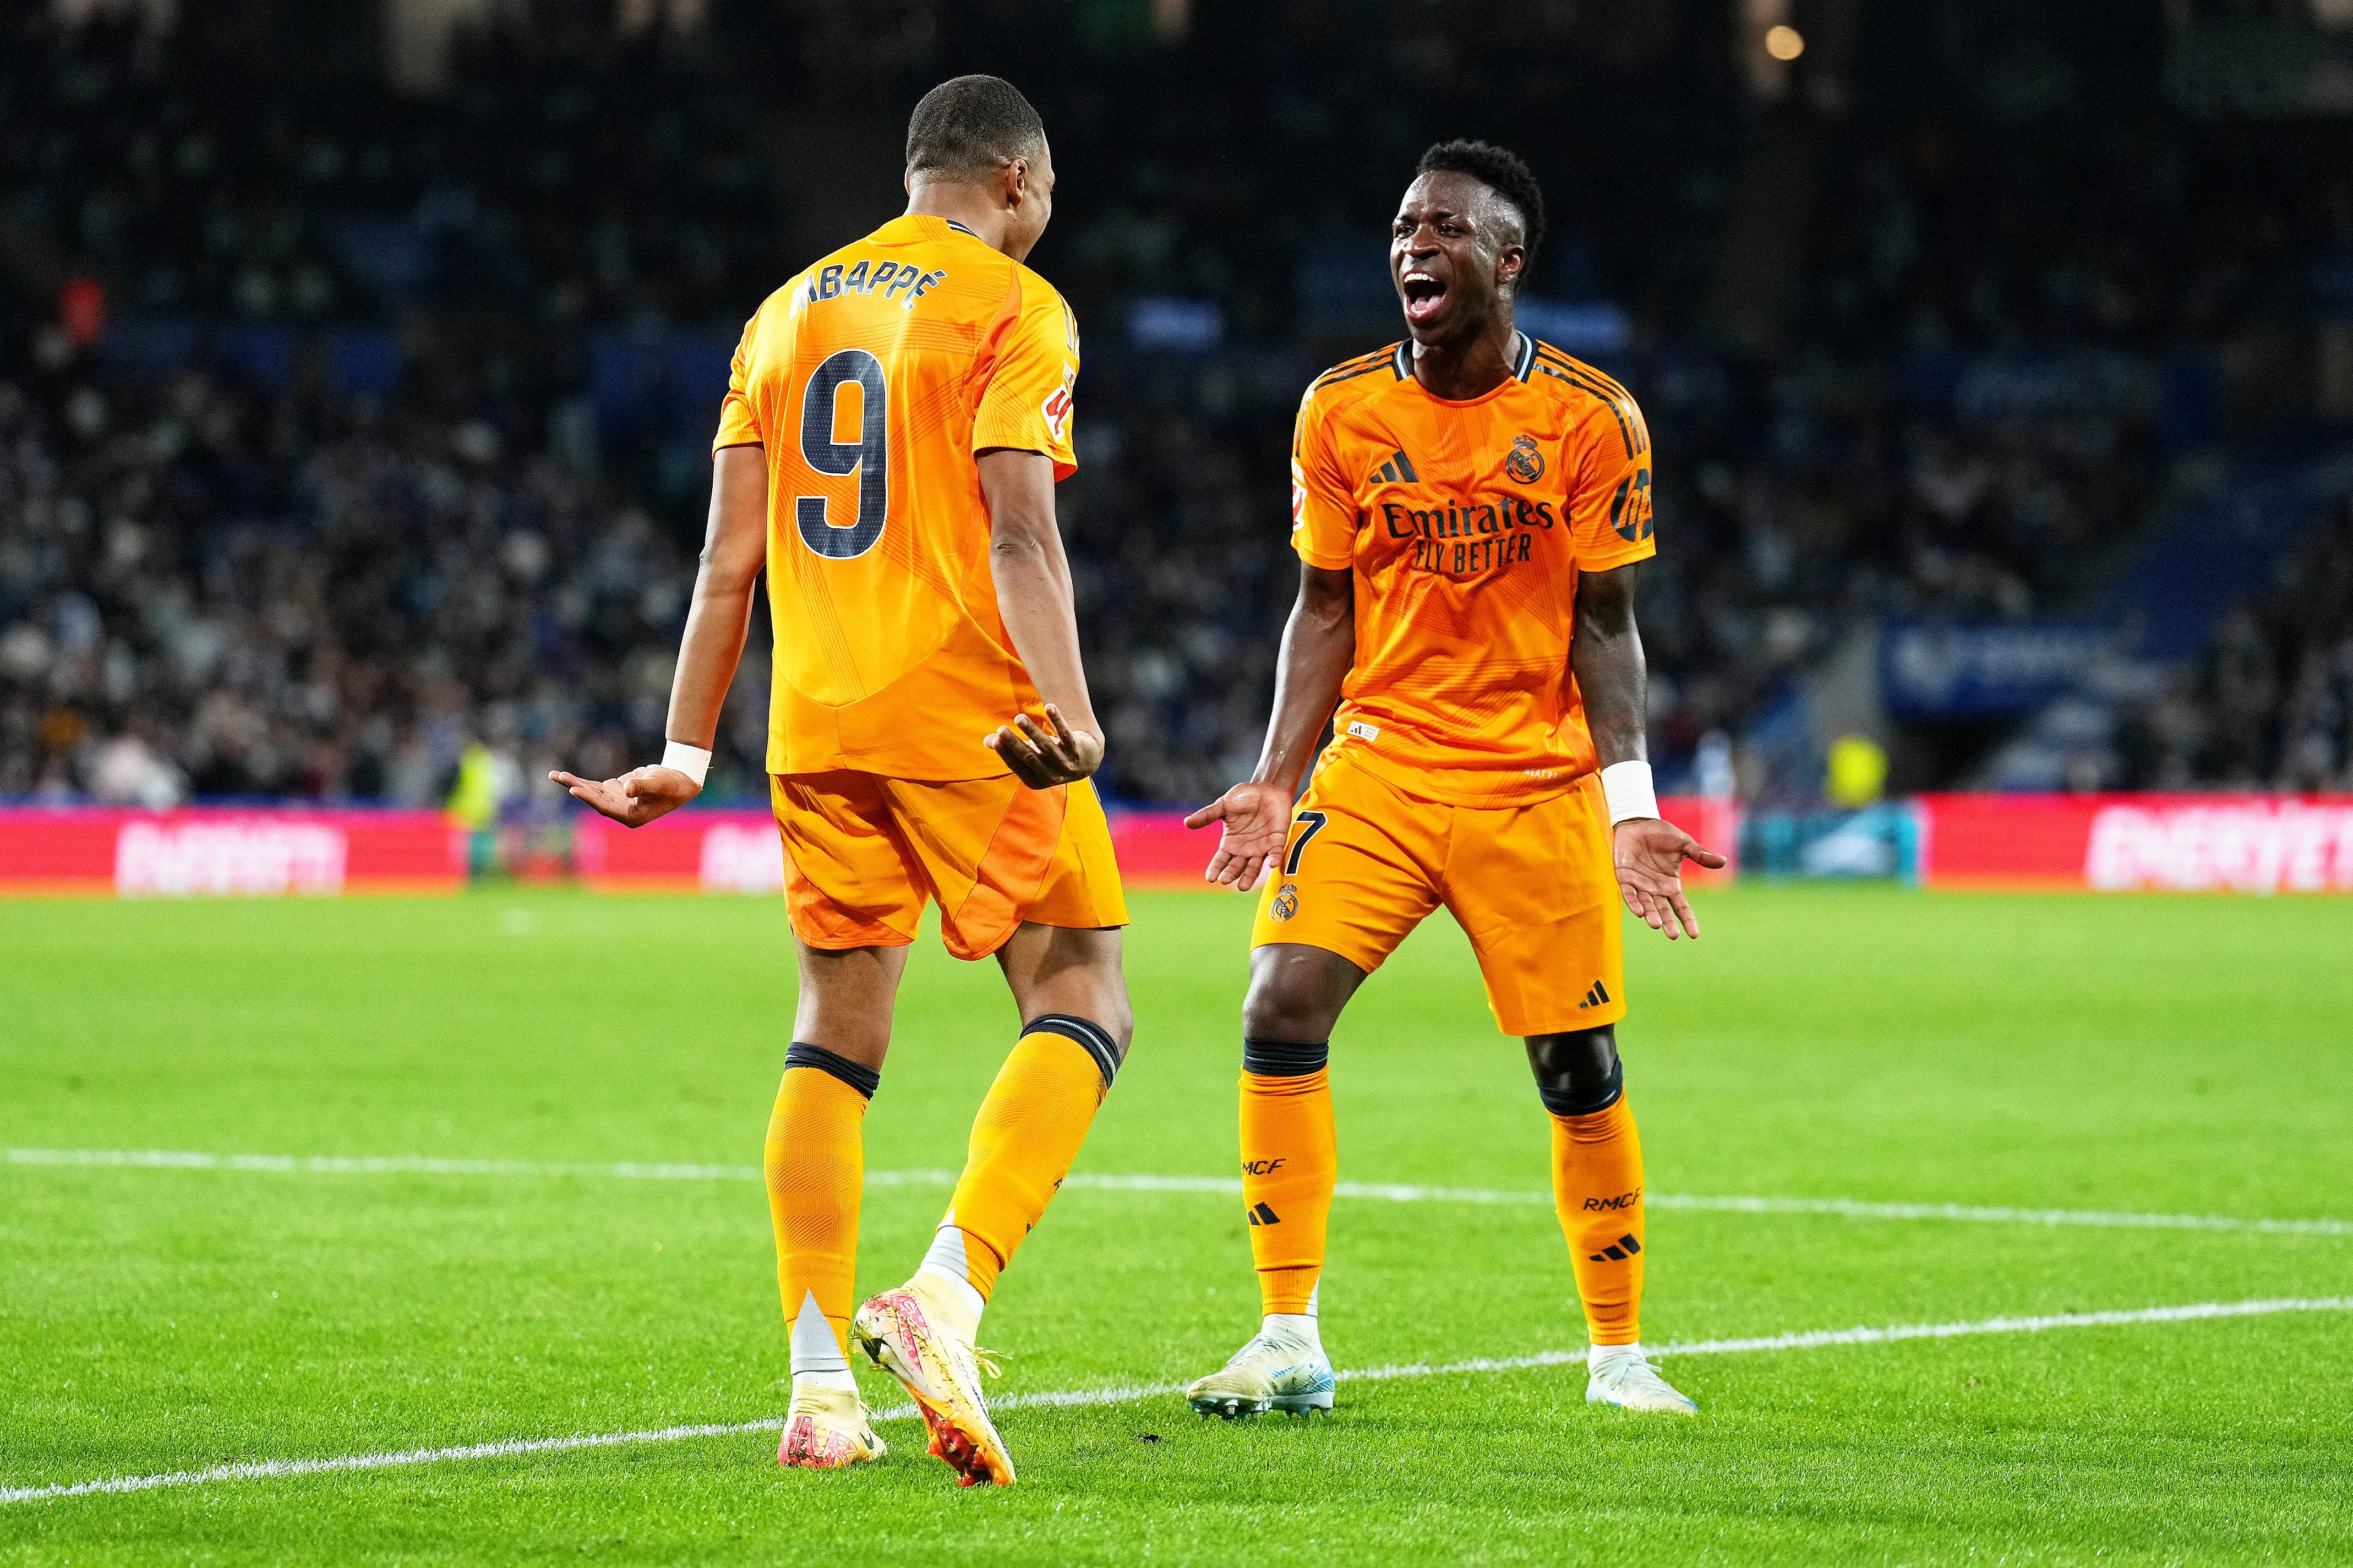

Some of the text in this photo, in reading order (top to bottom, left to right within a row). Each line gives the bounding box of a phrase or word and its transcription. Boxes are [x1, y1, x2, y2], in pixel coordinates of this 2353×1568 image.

[789, 260, 948, 319] MBAPPÉ
[795, 348, 888, 560] 9
[1380, 495, 1554, 539] Emirates
[1416, 533, 1532, 574] FLY BETTER
[1284, 810, 1329, 876] 7
[1242, 1159, 1286, 1175] MCF
